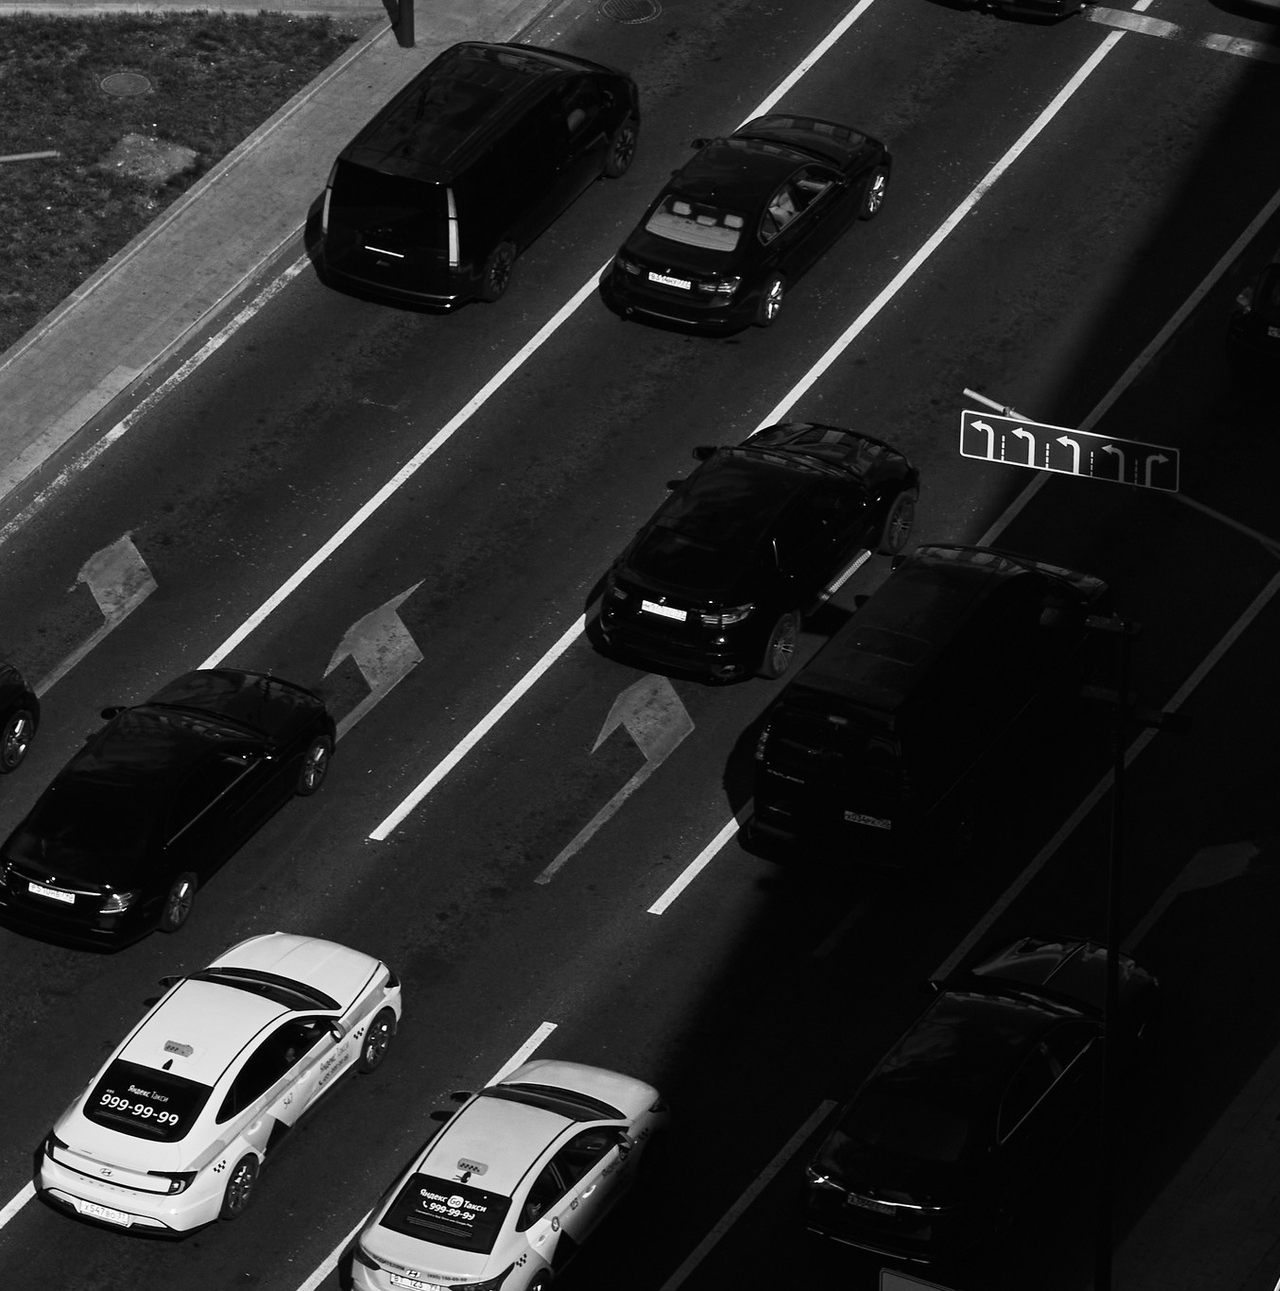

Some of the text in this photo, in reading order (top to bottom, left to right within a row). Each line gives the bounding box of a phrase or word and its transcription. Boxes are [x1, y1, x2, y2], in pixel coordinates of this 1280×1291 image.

[151, 1090, 170, 1103] Такси
[99, 1093, 180, 1126] 999-99-99
[420, 1188, 449, 1203] Яндекс
[463, 1200, 488, 1213] Такси
[428, 1202, 476, 1221] 999-99-99
